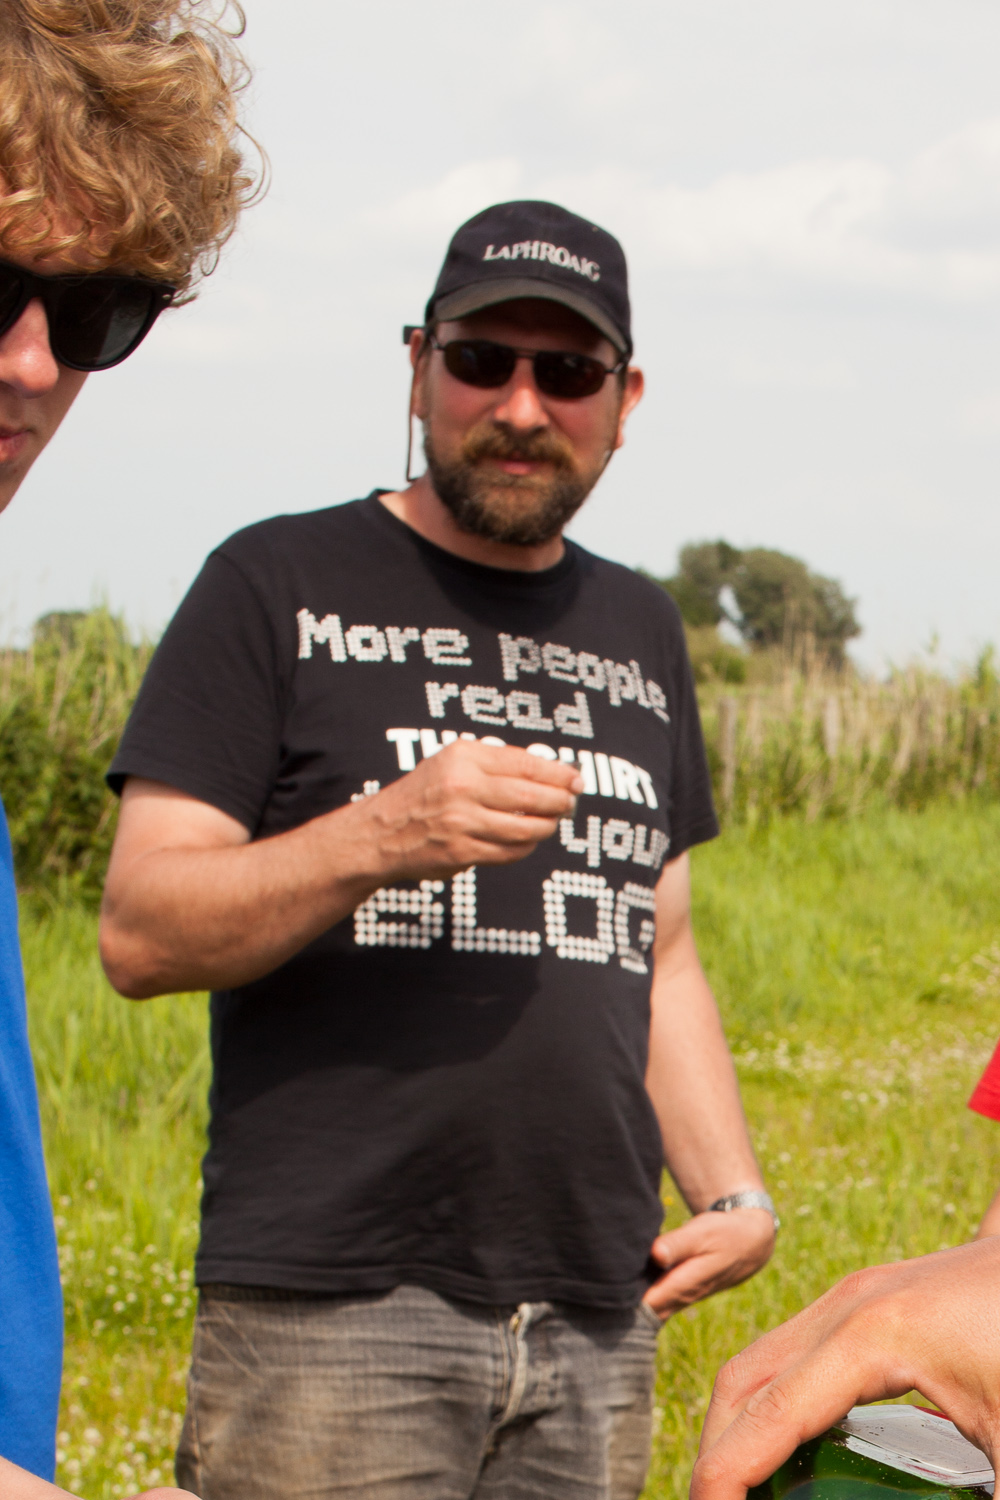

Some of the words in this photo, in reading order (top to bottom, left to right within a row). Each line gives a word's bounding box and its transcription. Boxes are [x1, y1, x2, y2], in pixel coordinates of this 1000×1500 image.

[482, 240, 601, 282] LAPHROAIG
[297, 608, 472, 666] More
[498, 632, 670, 724] people
[425, 682, 594, 739] read
[383, 728, 507, 772] TH
[354, 865, 657, 975] BLOG
